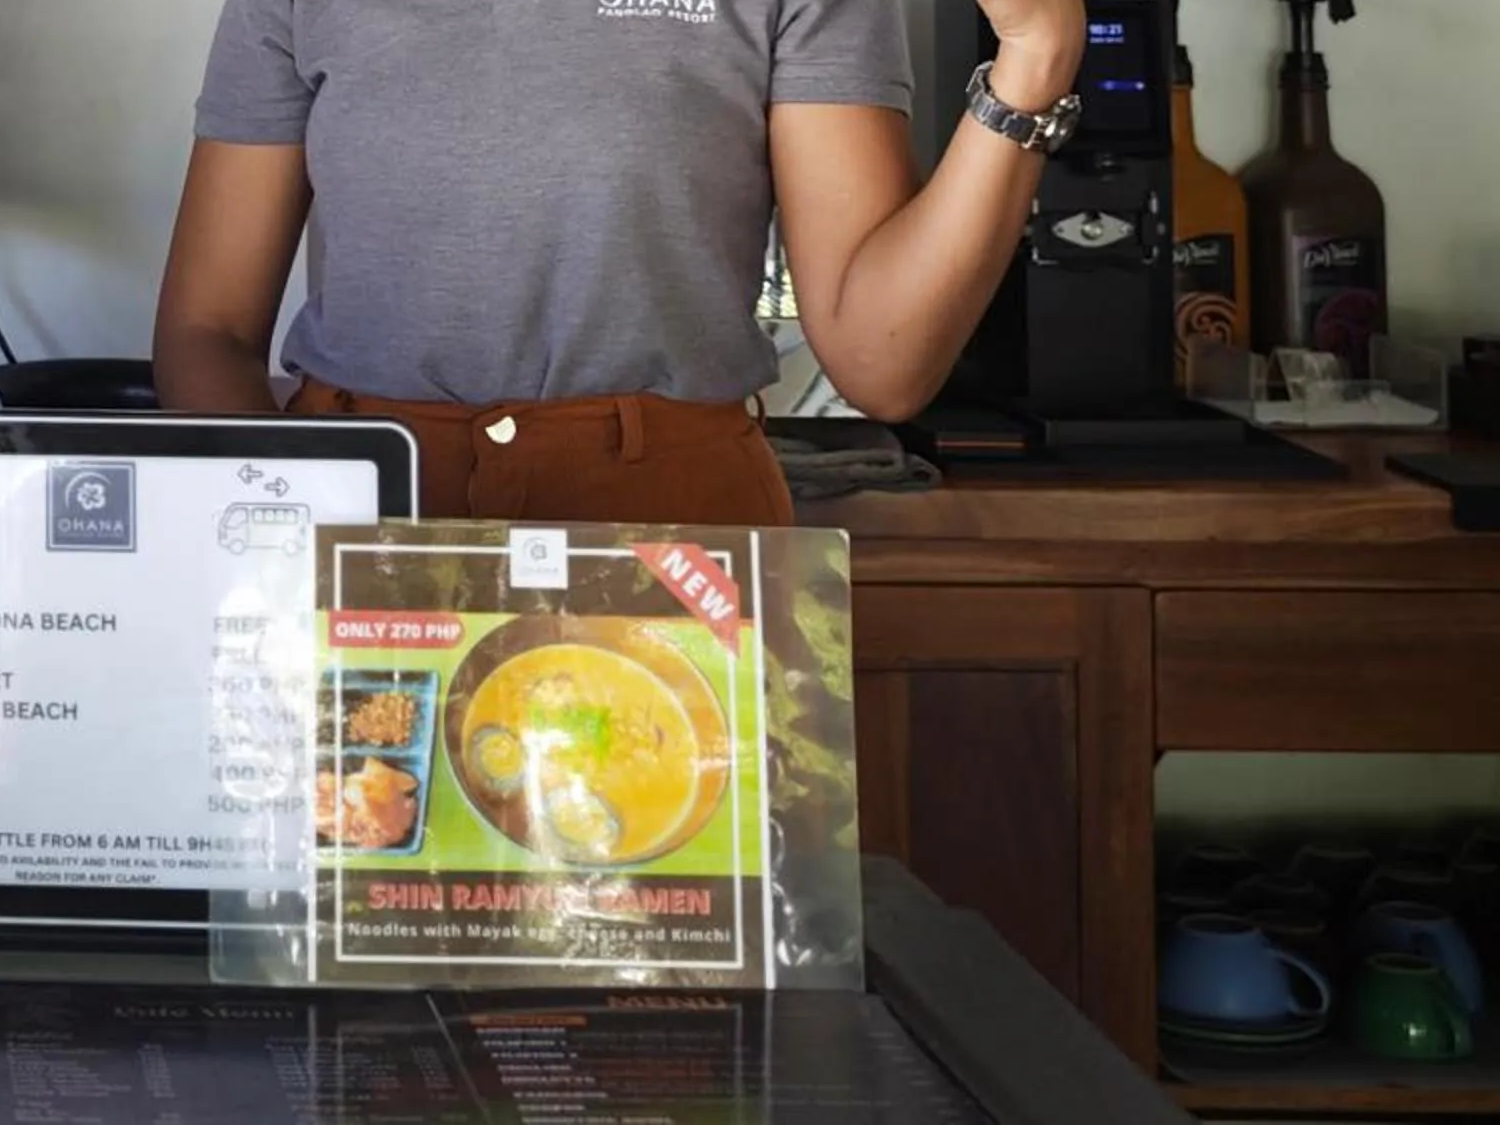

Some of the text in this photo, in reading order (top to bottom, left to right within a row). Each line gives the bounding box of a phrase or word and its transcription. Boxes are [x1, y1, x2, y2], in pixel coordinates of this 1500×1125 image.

[598, 7, 662, 17] PANGLAO
[58, 517, 124, 532] OHANA
[657, 544, 737, 625] NEW
[39, 611, 118, 633] BEACH
[334, 620, 461, 641] ONLY 270 PHP
[1, 700, 78, 722] BEACH
[41, 832, 92, 849] FROM
[97, 834, 108, 849] 6
[113, 834, 141, 851] AM
[146, 836, 181, 851] TILL
[82, 856, 108, 868] AND
[111, 857, 131, 868] THE
[162, 858, 176, 869] TO
[15, 870, 112, 884] REASON FOR ANY
[367, 883, 443, 911] SHIN
[452, 884, 591, 912] RAMYU
[347, 922, 418, 938] Noodles
[423, 923, 461, 938] with
[467, 924, 522, 942] Mayak
[634, 926, 665, 942] and
[671, 928, 731, 943] Kimchi
